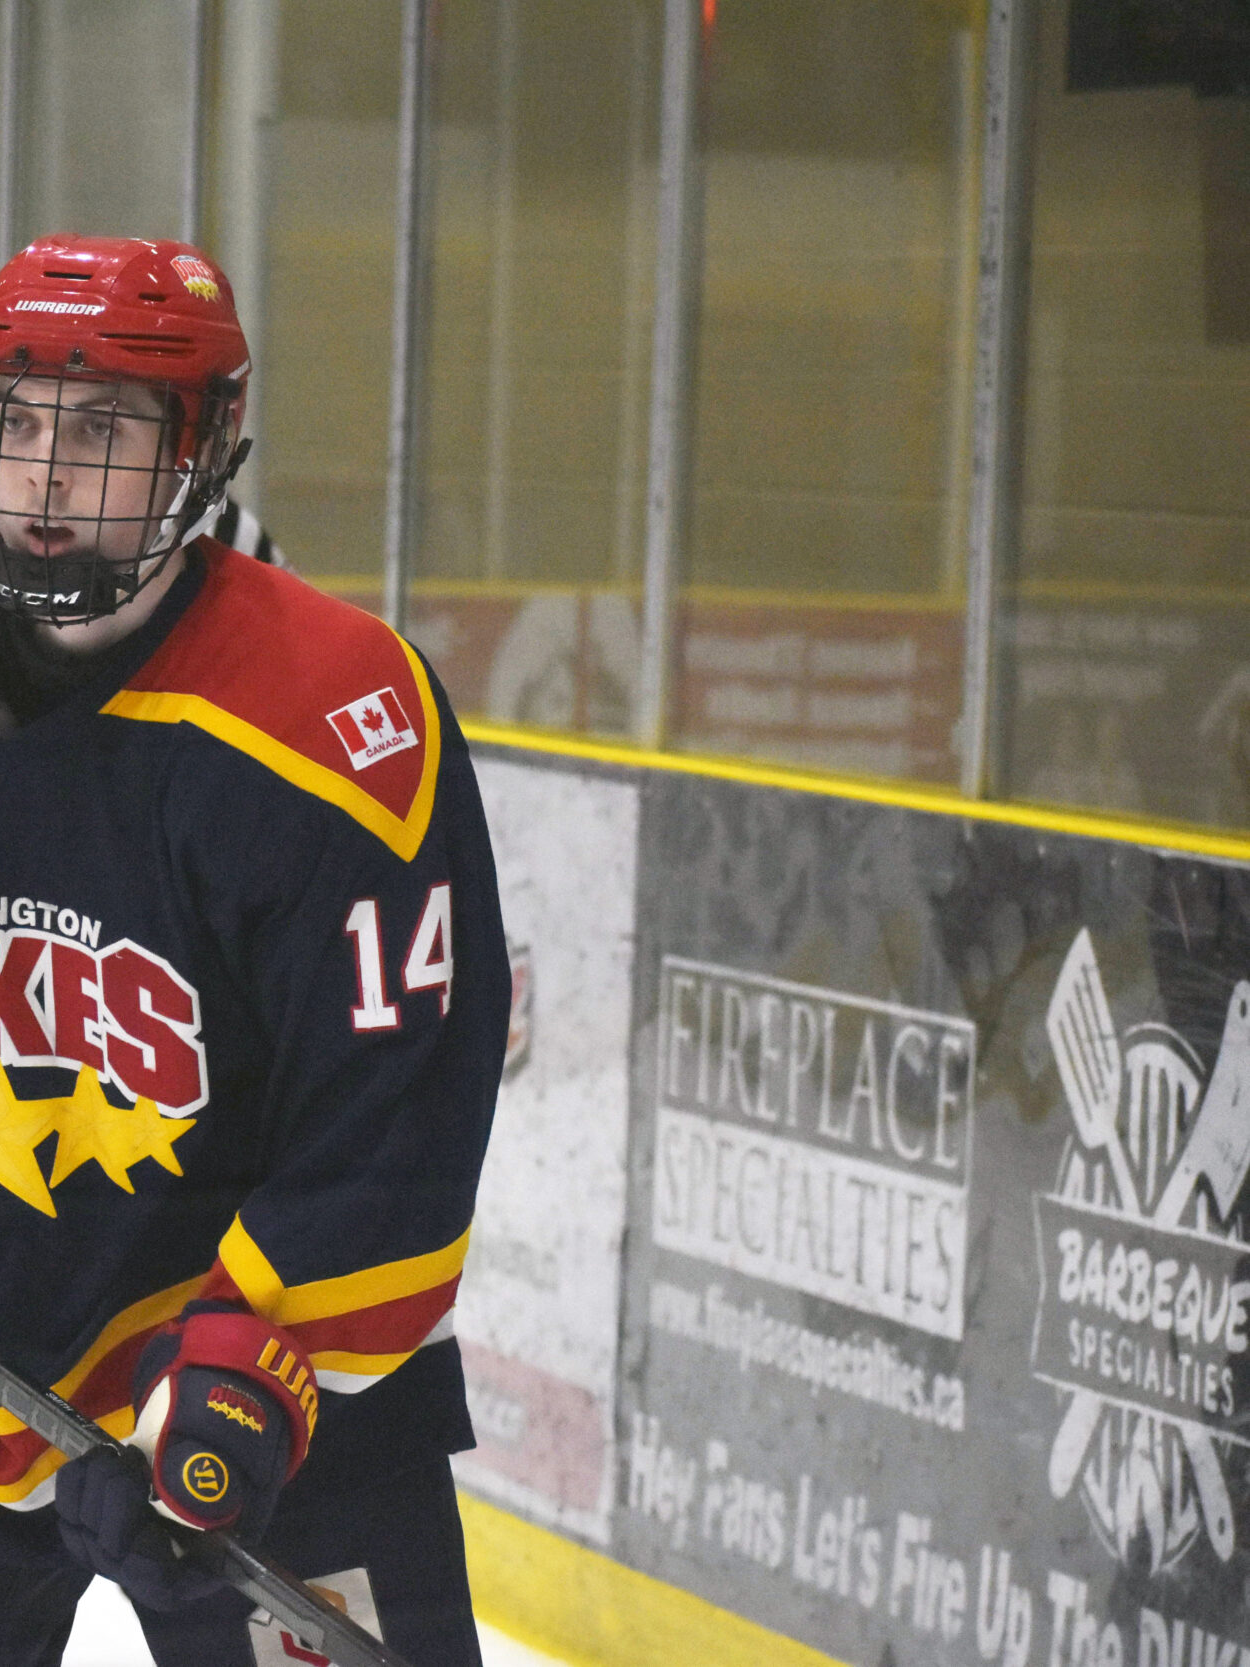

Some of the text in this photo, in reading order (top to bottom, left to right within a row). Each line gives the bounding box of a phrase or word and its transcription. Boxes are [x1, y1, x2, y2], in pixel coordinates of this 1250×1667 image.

[14, 300, 104, 316] WARRIOR
[366, 734, 406, 759] CANADA
[344, 880, 454, 1033] 14
[664, 973, 967, 1171] FIREPLACE
[659, 1122, 956, 1318] SPECIALTIES
[1057, 1227, 1250, 1354] BARBEQUE
[1068, 1317, 1235, 1418] SPECIALTIES
[702, 1439, 786, 1569] Fans
[792, 1473, 882, 1610] Let's
[887, 1510, 968, 1644] Fire
[976, 1543, 1033, 1667] Up
[1048, 1569, 1124, 1667] The
